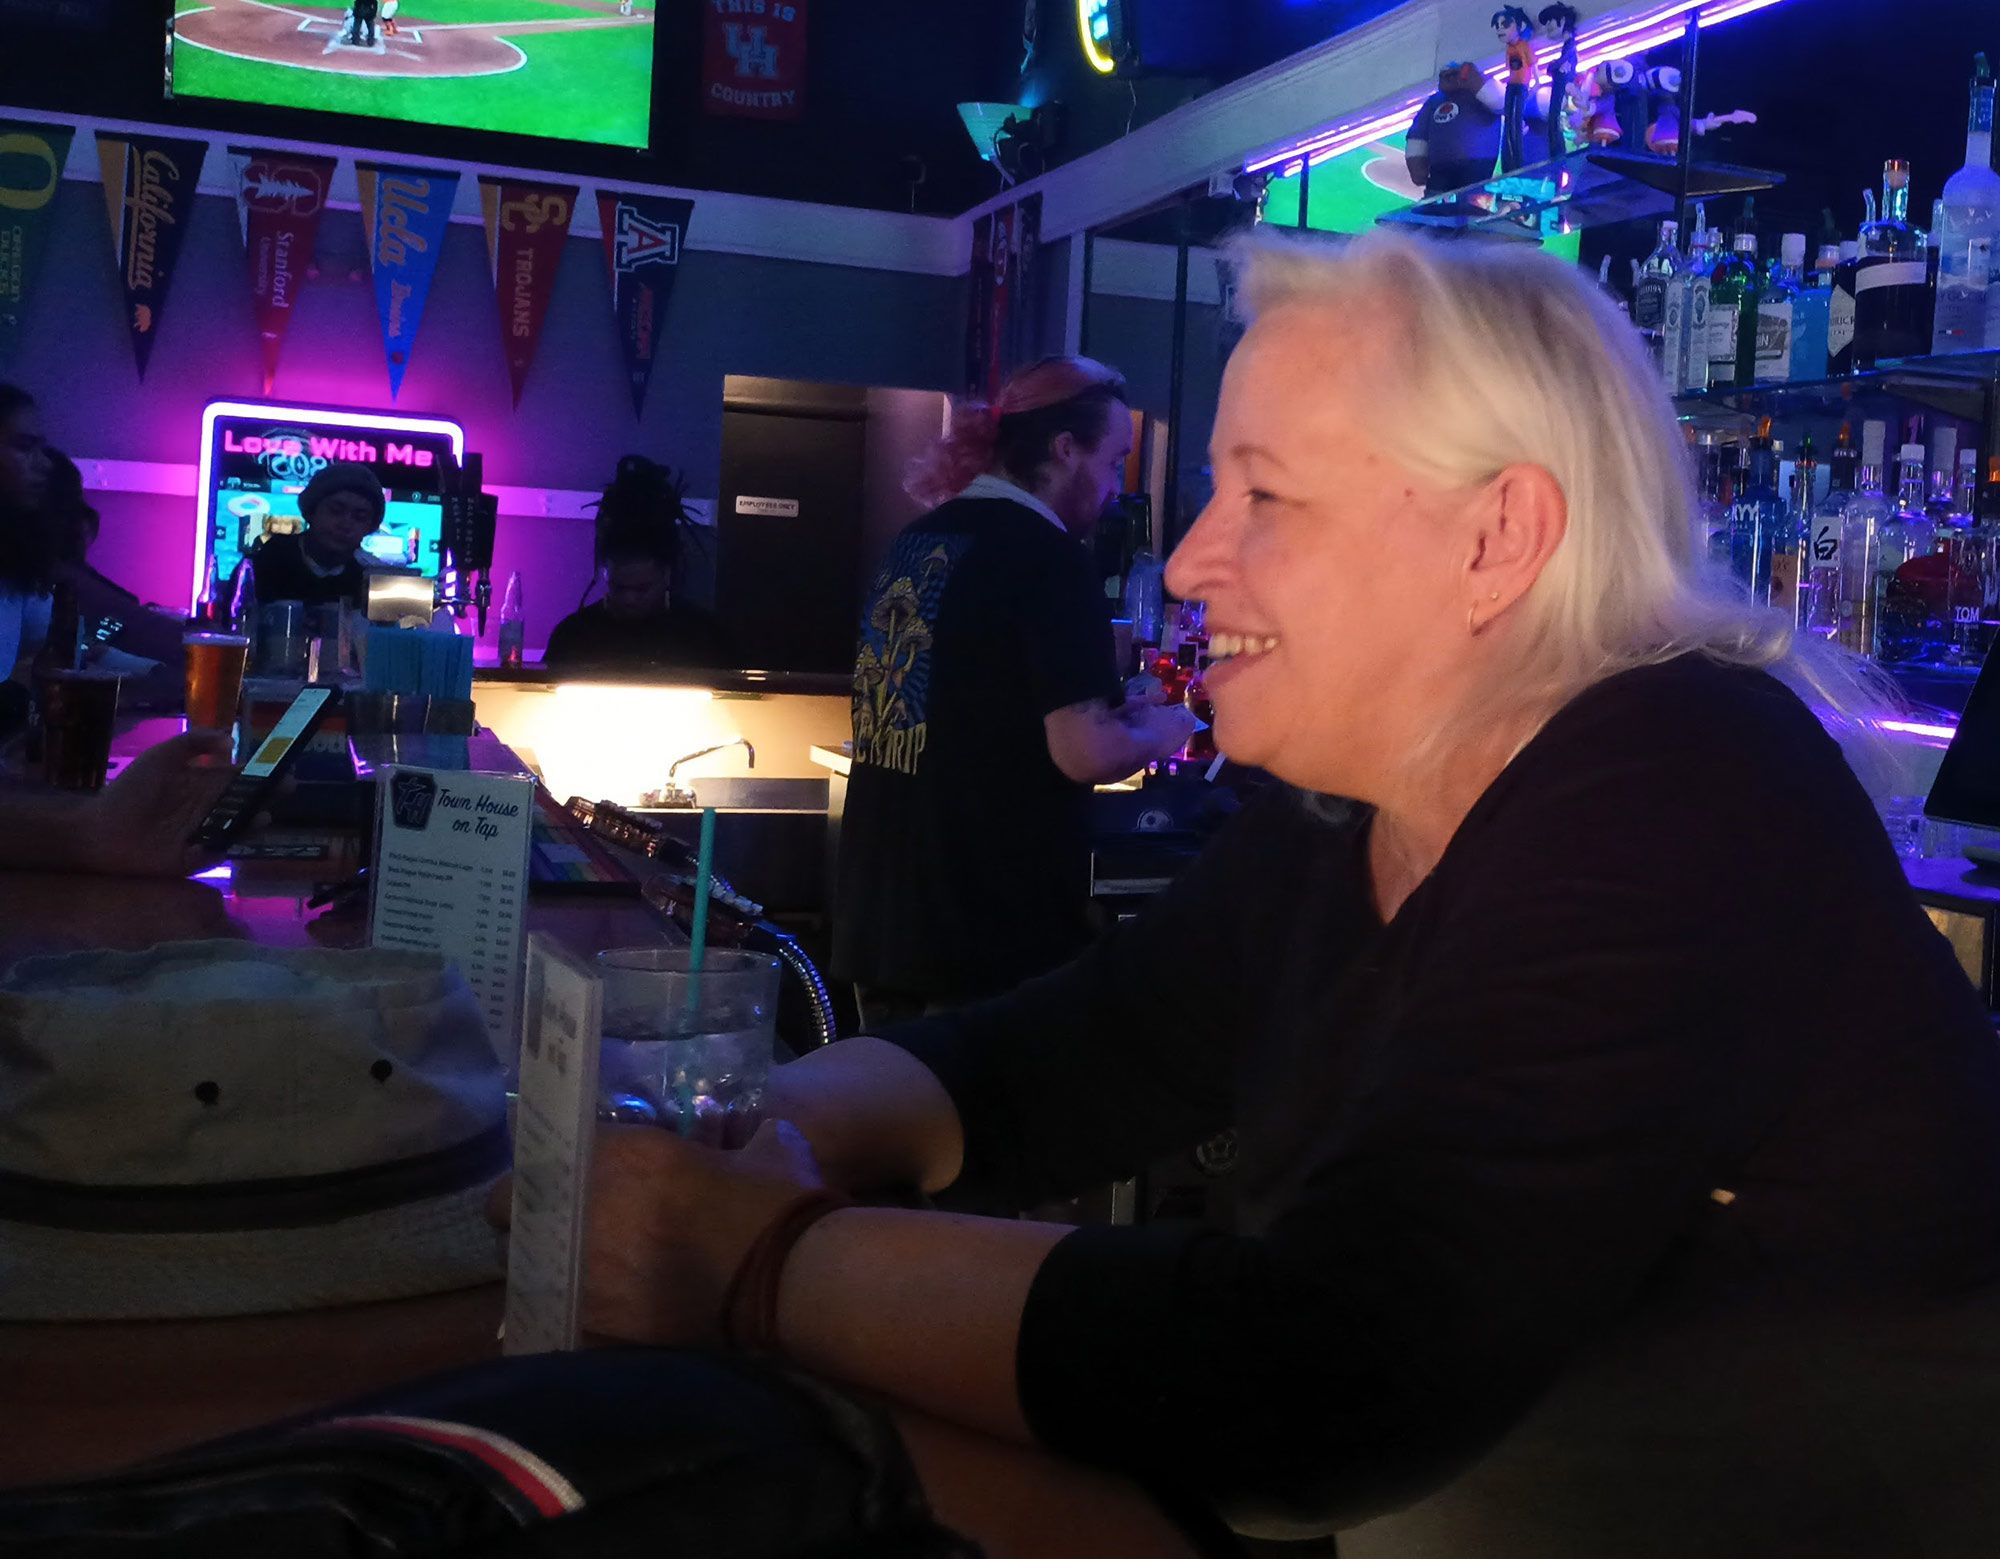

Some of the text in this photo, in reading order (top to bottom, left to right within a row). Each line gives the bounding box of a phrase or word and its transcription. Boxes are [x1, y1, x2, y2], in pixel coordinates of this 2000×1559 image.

[773, 3, 797, 22] IS
[710, 82, 797, 109] COUNTRY
[124, 146, 182, 291] California
[614, 200, 680, 273] A
[272, 230, 296, 309] Stanford
[512, 247, 535, 337] TROJANS
[223, 429, 434, 468] Love With Me
[1954, 606, 1980, 622] TOM
[437, 788, 472, 811] Town
[474, 794, 519, 817] House
[452, 816, 499, 841] on Tap
